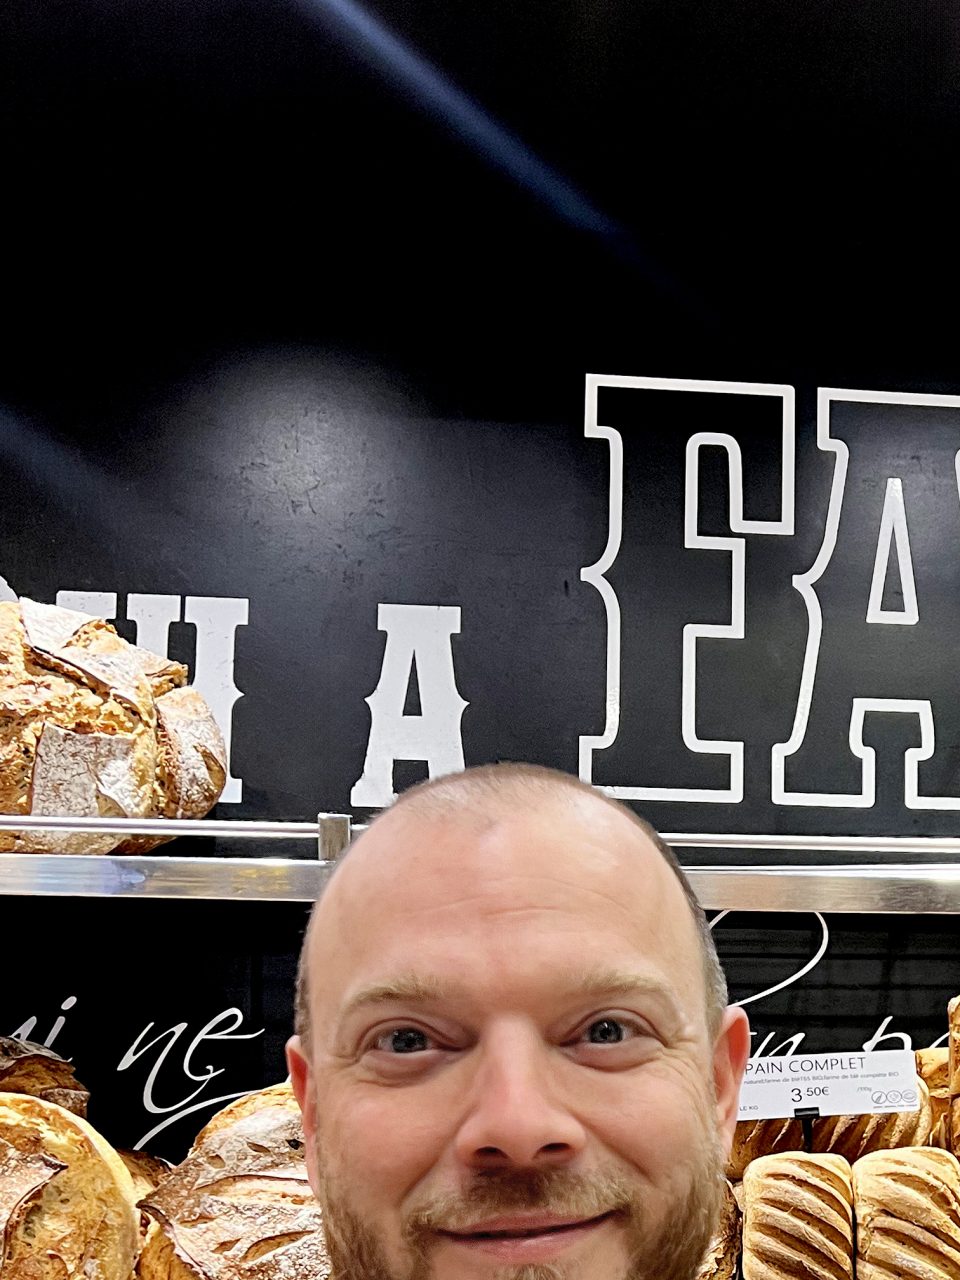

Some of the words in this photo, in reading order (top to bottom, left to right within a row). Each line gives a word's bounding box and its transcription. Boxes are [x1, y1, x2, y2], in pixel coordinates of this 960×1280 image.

[350, 603, 470, 807] A
[745, 1061, 783, 1076] PAIN
[788, 1057, 866, 1073] COMPLET
